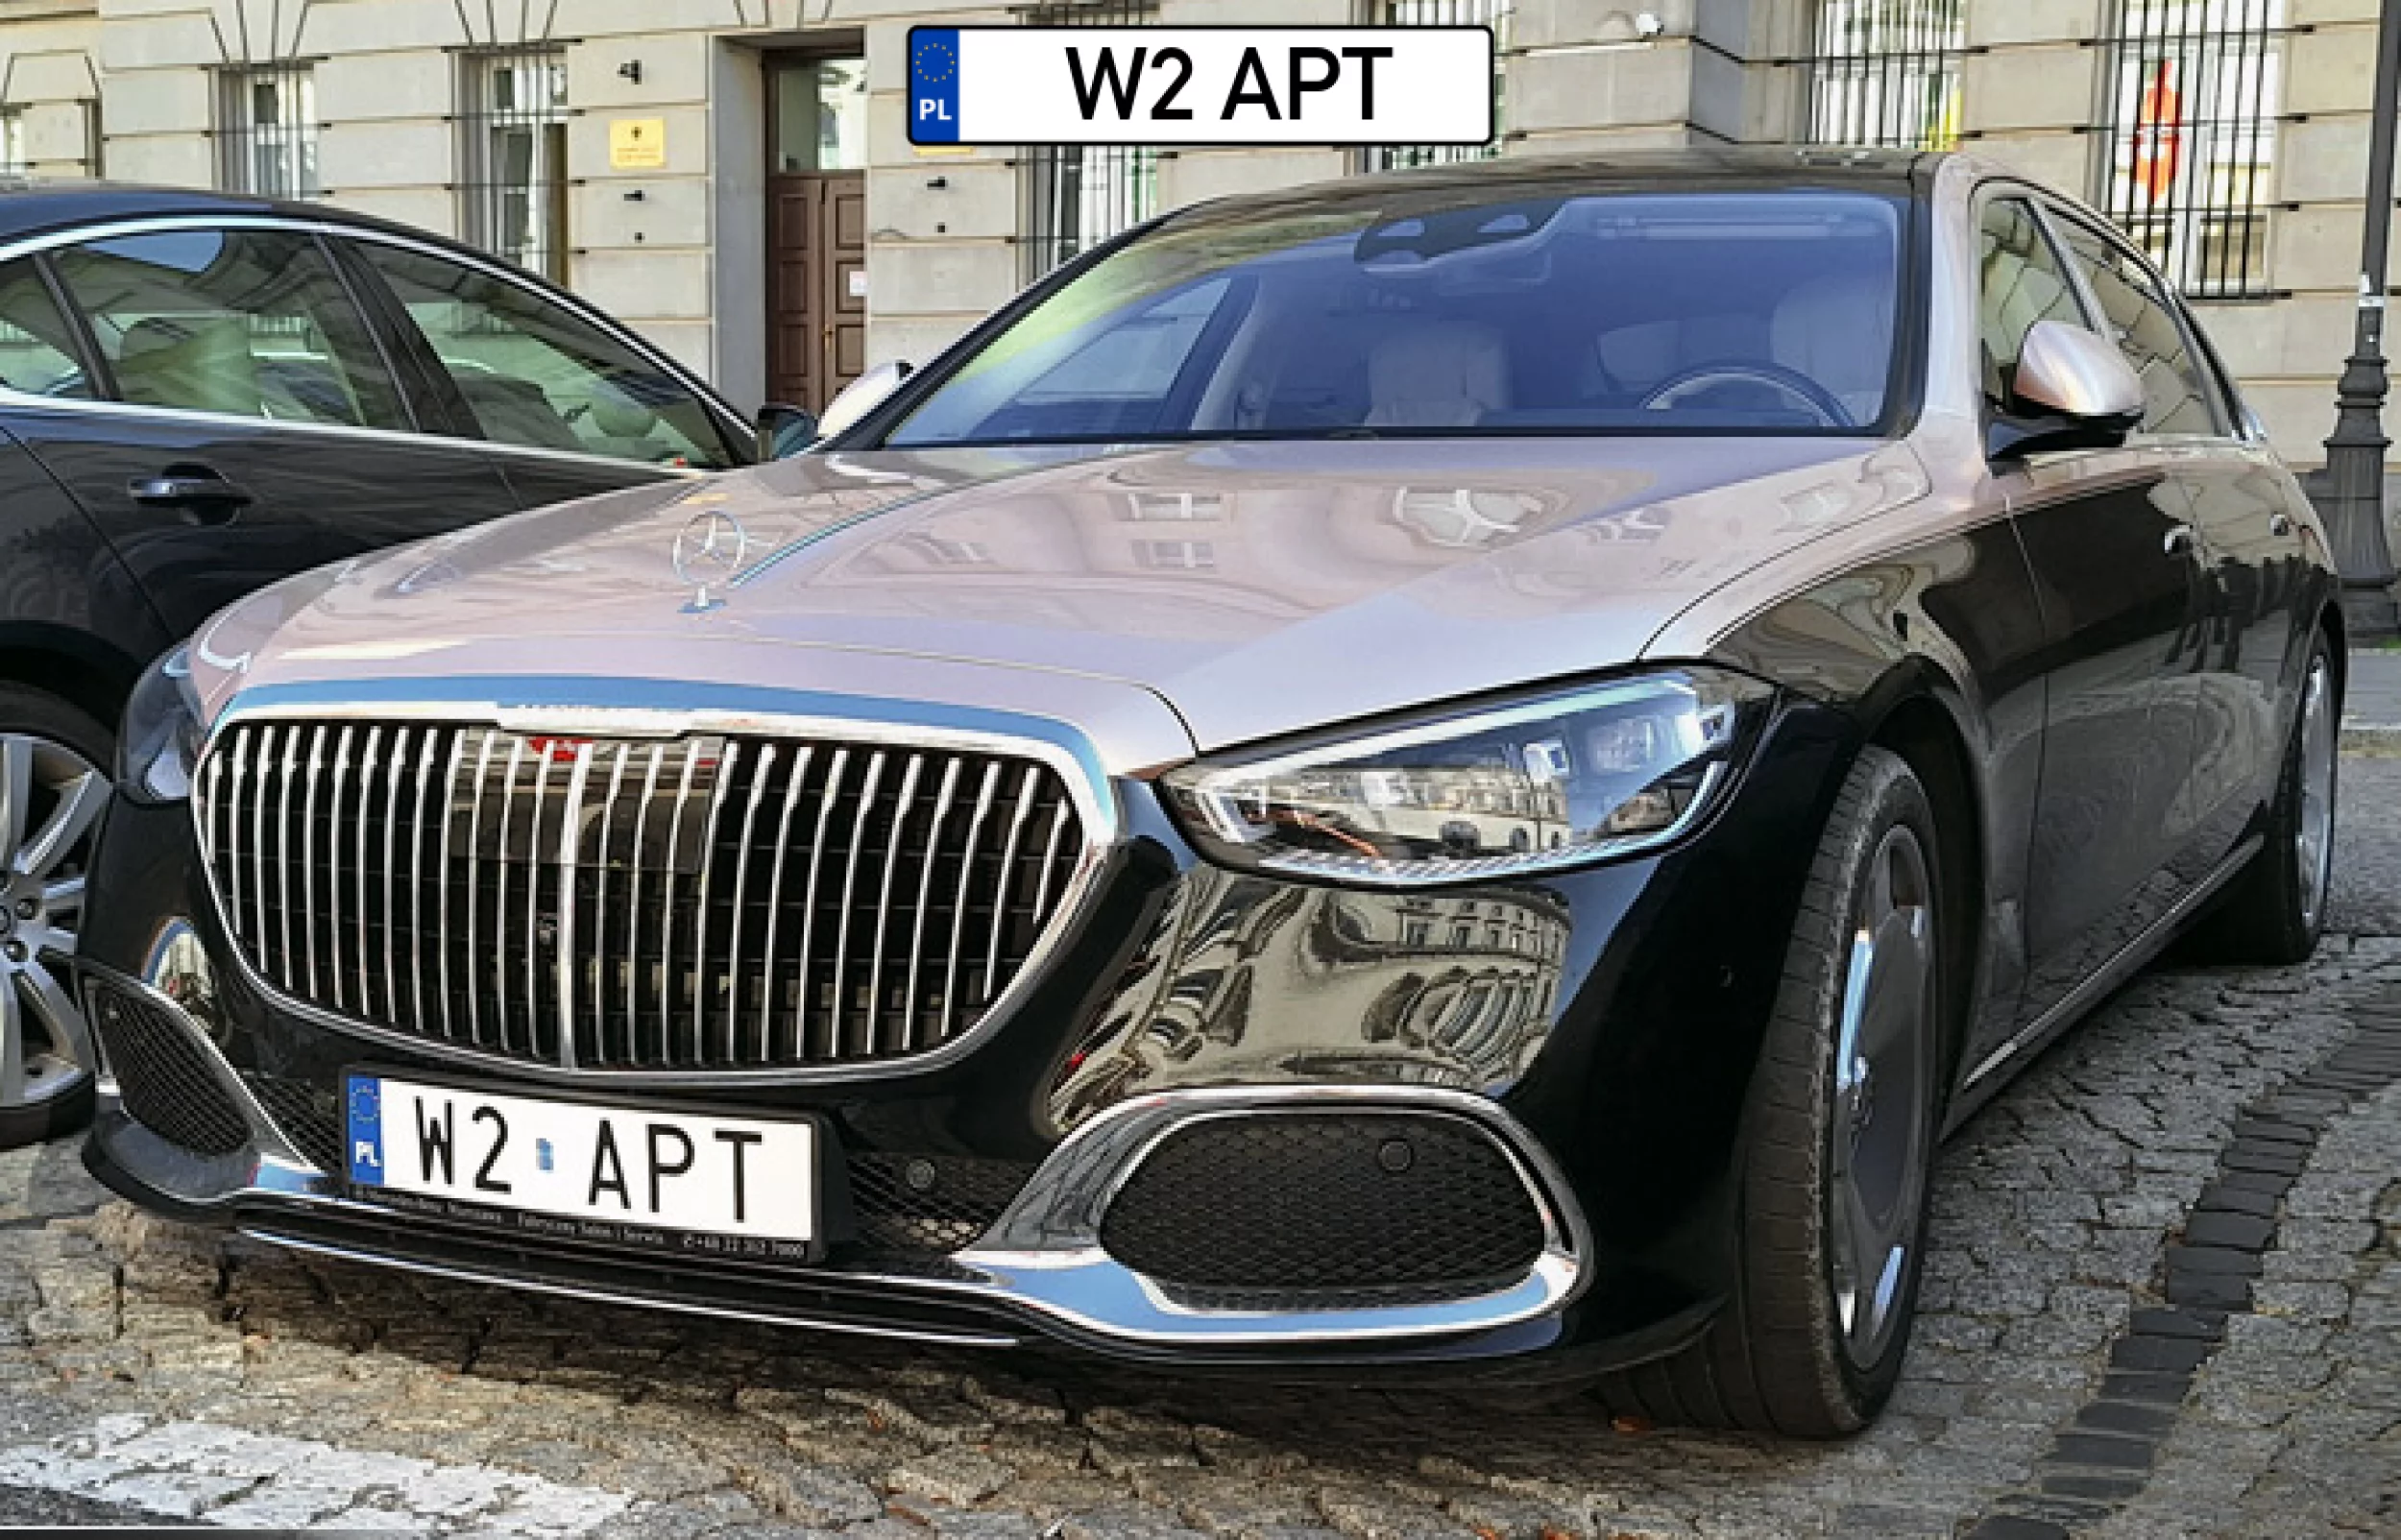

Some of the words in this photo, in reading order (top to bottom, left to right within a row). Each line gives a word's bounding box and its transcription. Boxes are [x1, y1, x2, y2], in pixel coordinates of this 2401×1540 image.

[355, 1140, 381, 1167] PL
[415, 1095, 513, 1194] W2
[588, 1117, 764, 1223] APT
